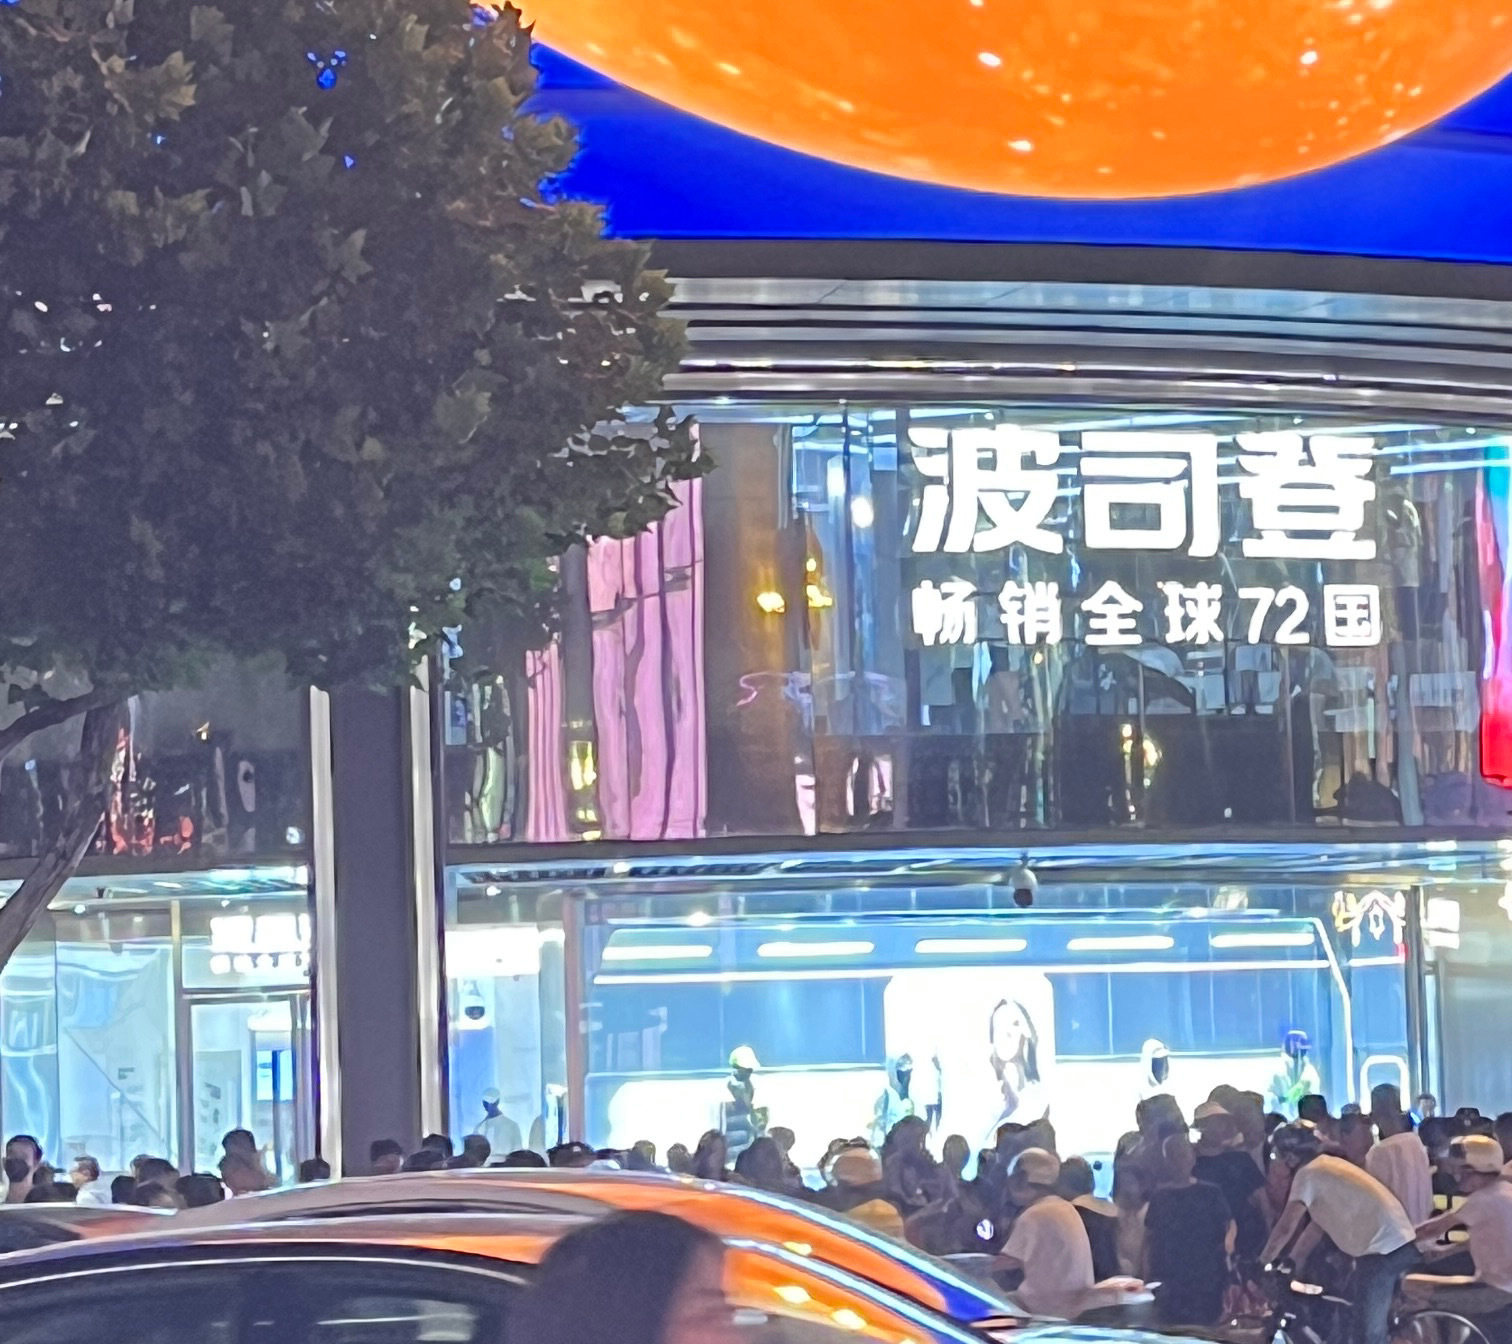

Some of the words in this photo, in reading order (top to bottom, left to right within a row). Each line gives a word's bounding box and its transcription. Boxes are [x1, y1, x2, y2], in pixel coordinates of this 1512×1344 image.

[909, 425, 1377, 560] 波司登
[912, 579, 1382, 648] 畅销全球72国
